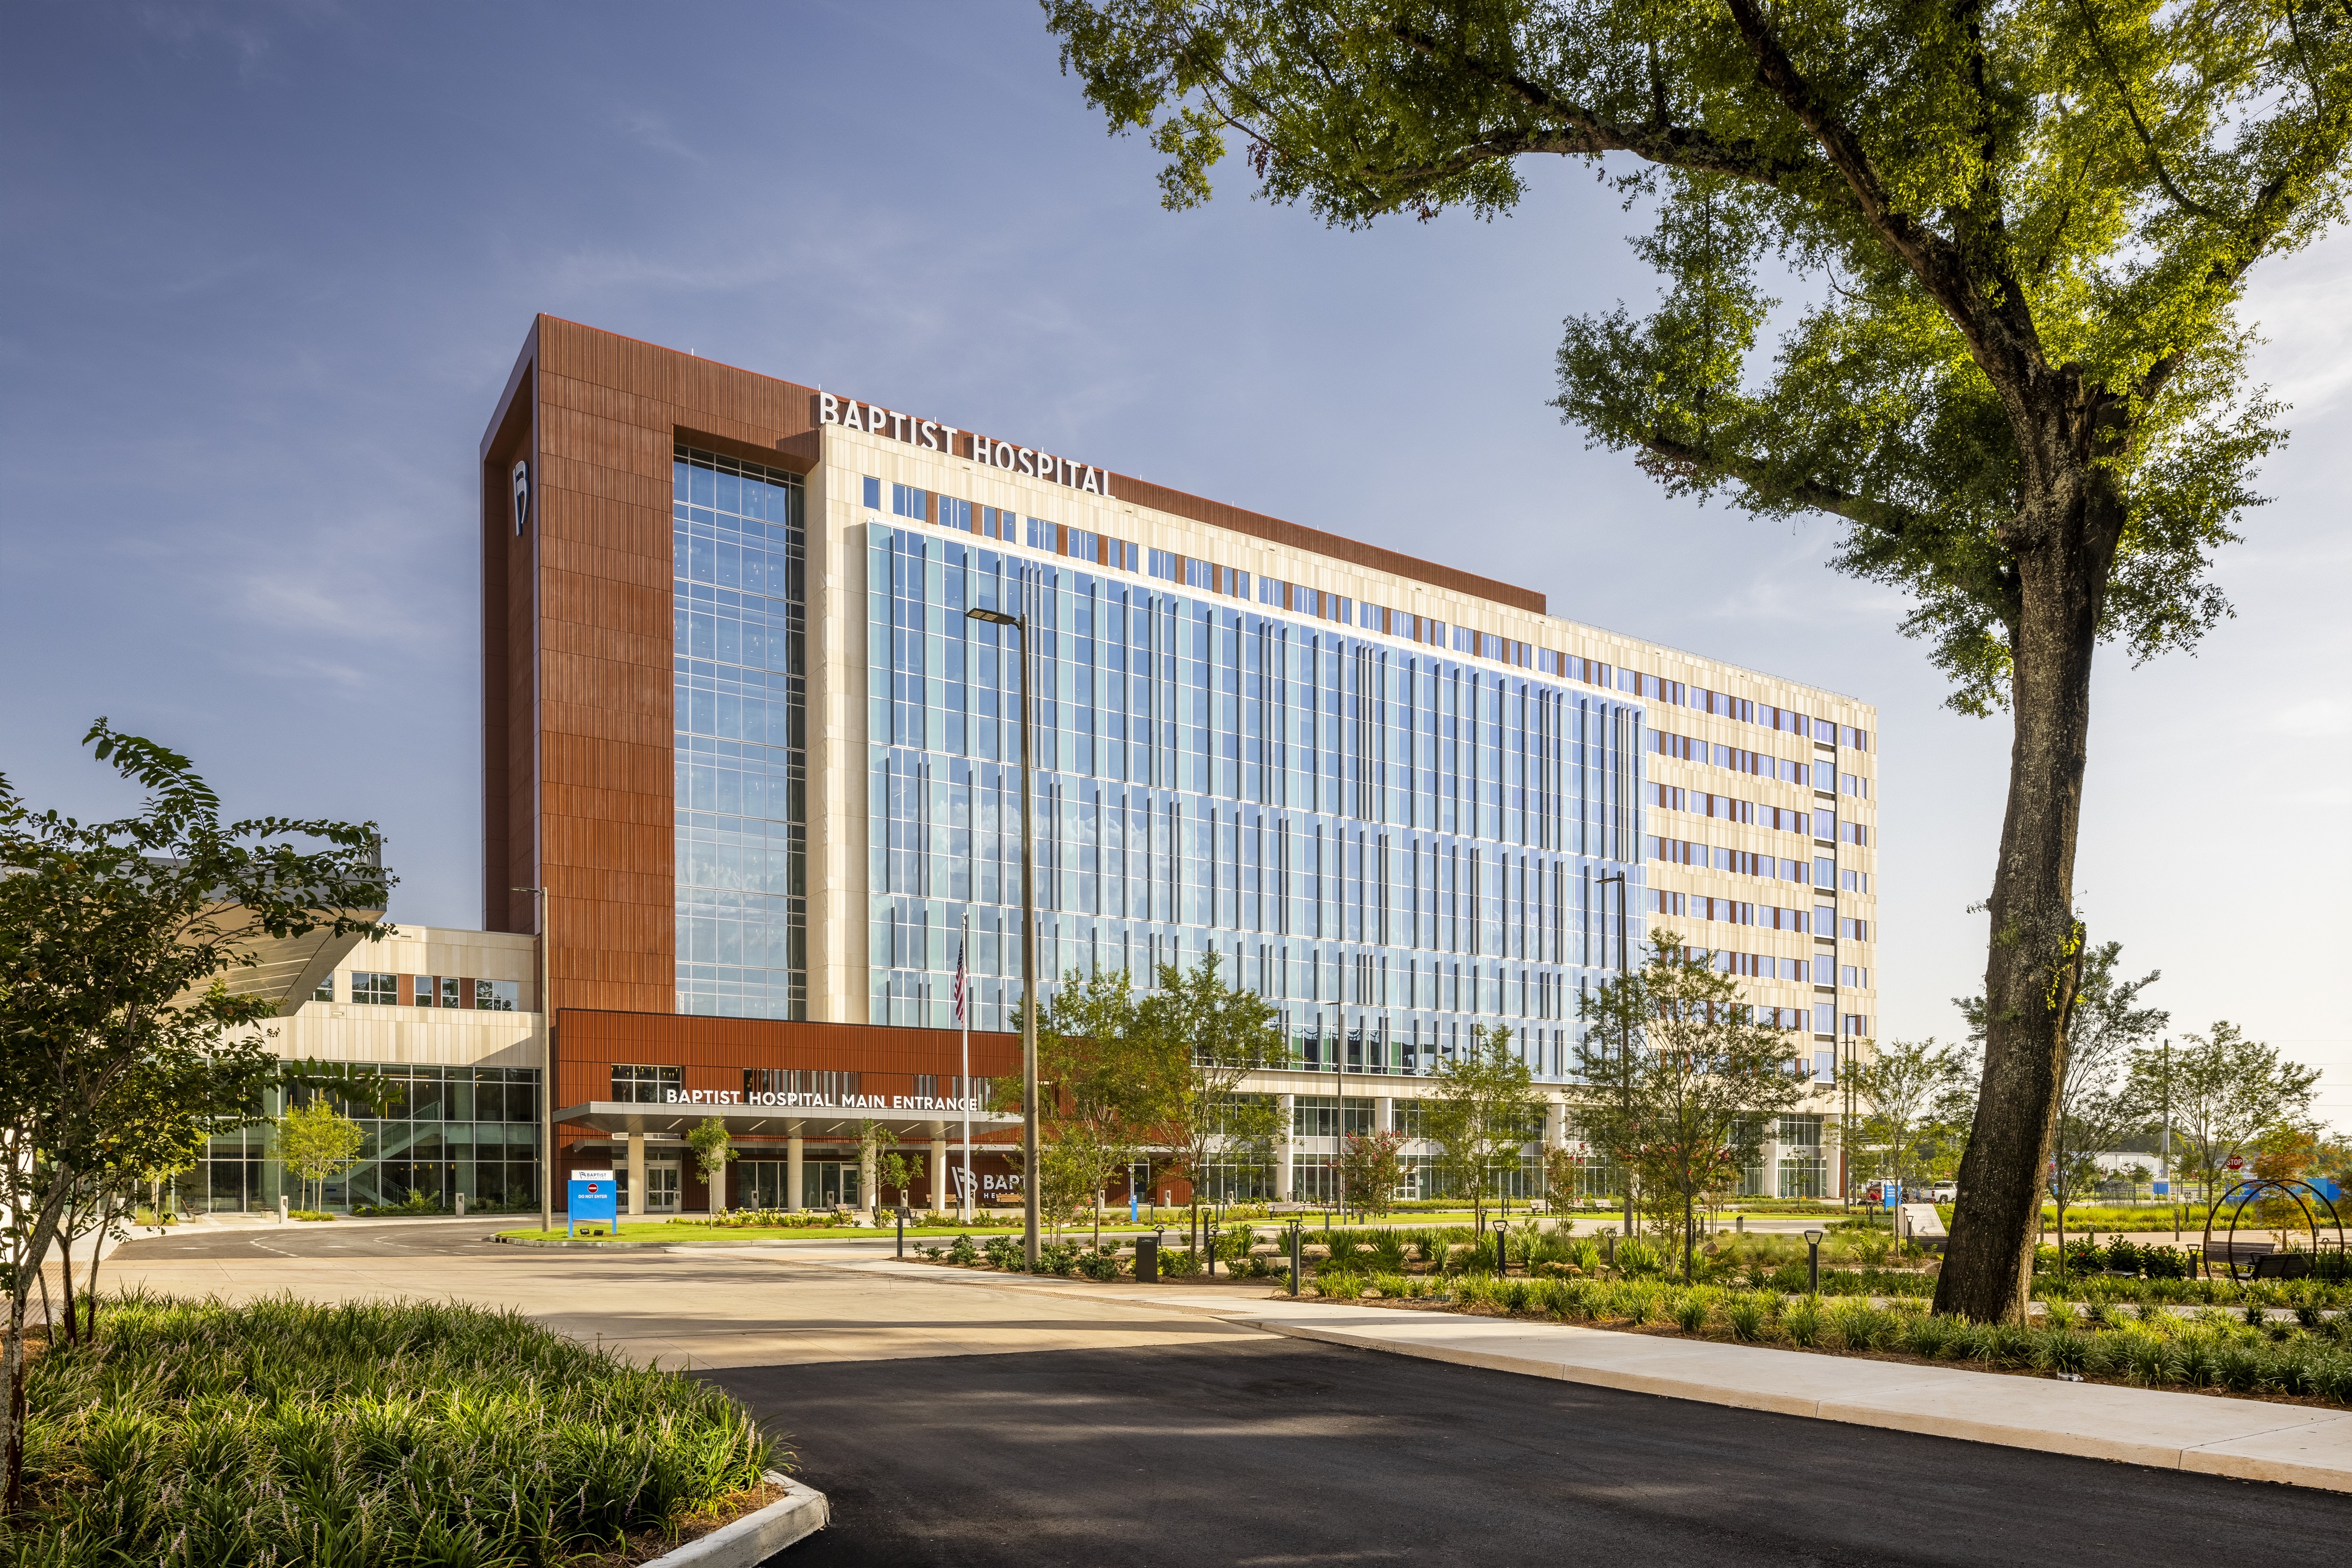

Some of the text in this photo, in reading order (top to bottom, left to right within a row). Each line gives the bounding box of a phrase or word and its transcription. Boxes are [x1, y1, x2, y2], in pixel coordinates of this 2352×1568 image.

[820, 391, 1115, 499] BAPTIST HOSPITAL
[666, 1089, 977, 1111] BAPTIST HOSPITAL MAIN ENTRANCE
